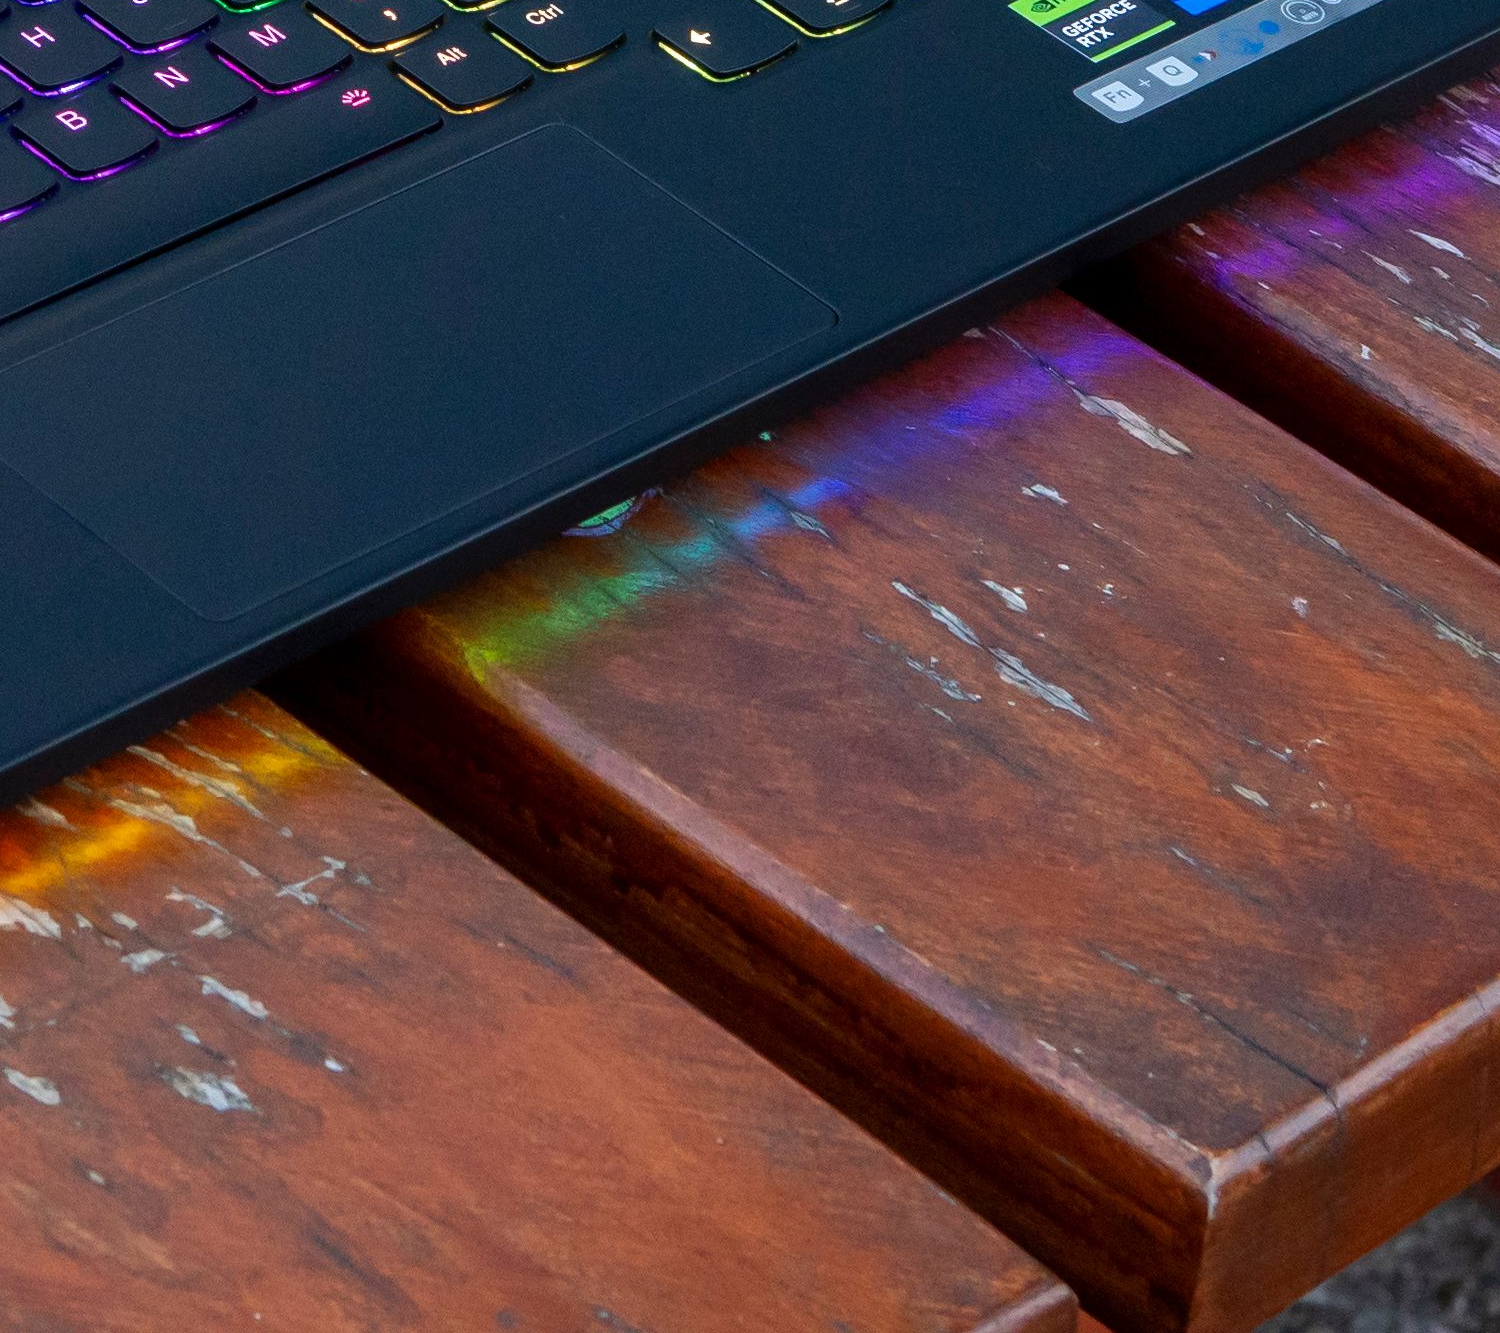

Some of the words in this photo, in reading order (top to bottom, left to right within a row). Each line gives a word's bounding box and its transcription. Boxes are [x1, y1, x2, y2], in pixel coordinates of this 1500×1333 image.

[525, 2, 564, 27] Ctrl
[1061, 0, 1137, 38] GEFORCE
[1076, 26, 1115, 48] RTX
[436, 43, 468, 67] Alt
[1102, 89, 1133, 103] Fn
[1162, 64, 1183, 76] Q
